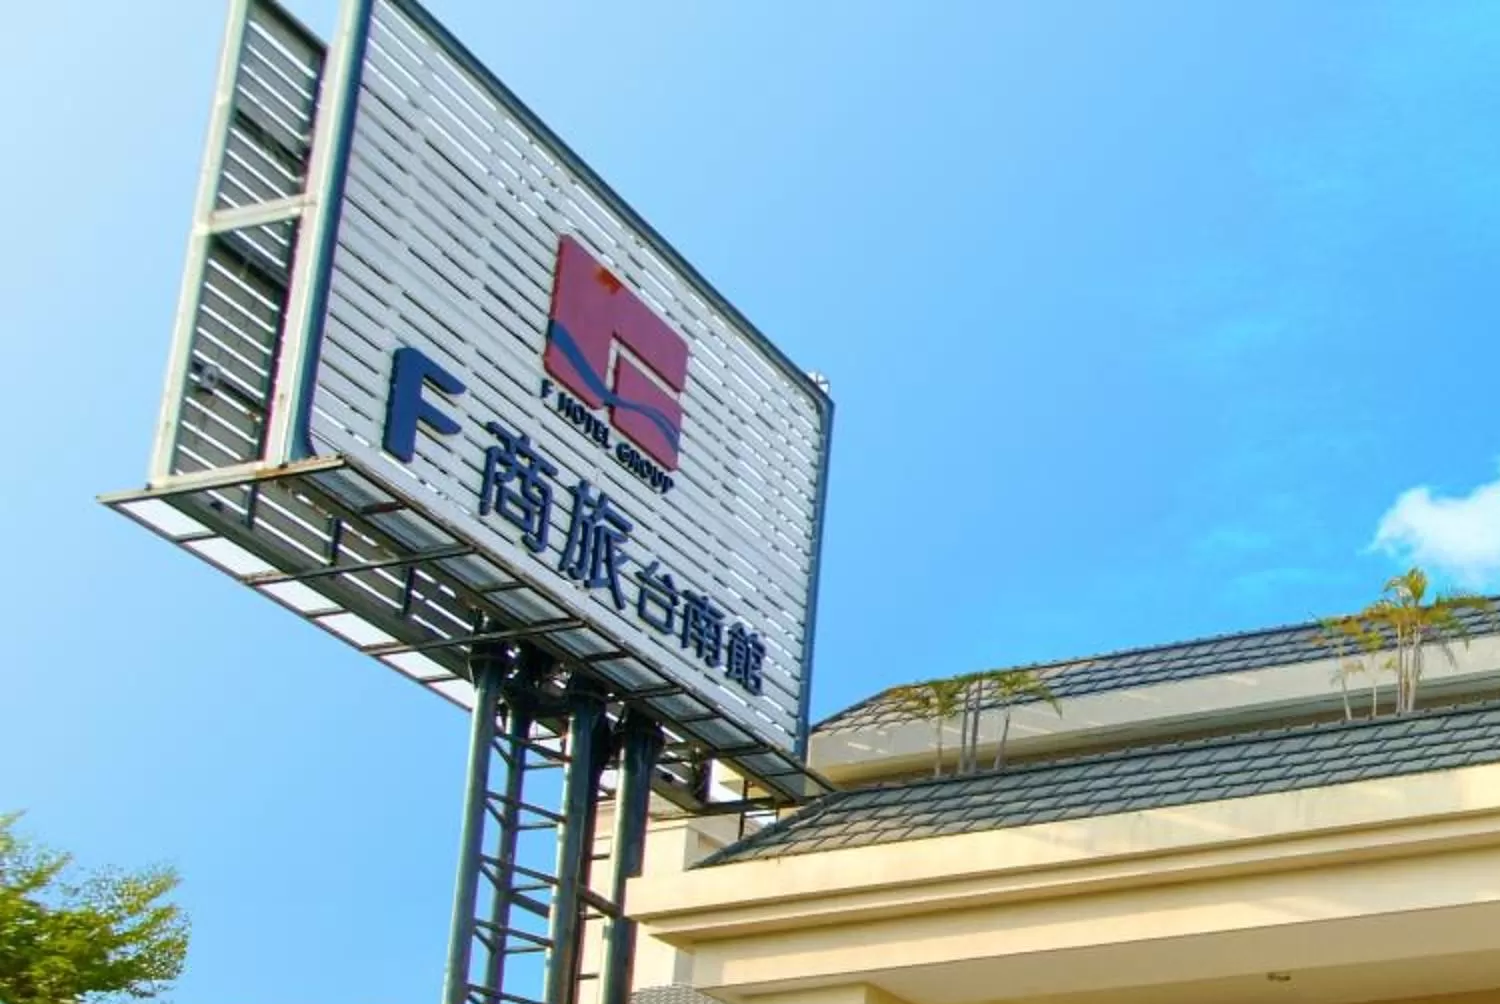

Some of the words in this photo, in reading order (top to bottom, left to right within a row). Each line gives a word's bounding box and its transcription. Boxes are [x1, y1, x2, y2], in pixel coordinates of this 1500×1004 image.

[541, 378, 554, 398] F
[558, 392, 611, 449] HOTEL
[615, 442, 674, 494] GROUP
